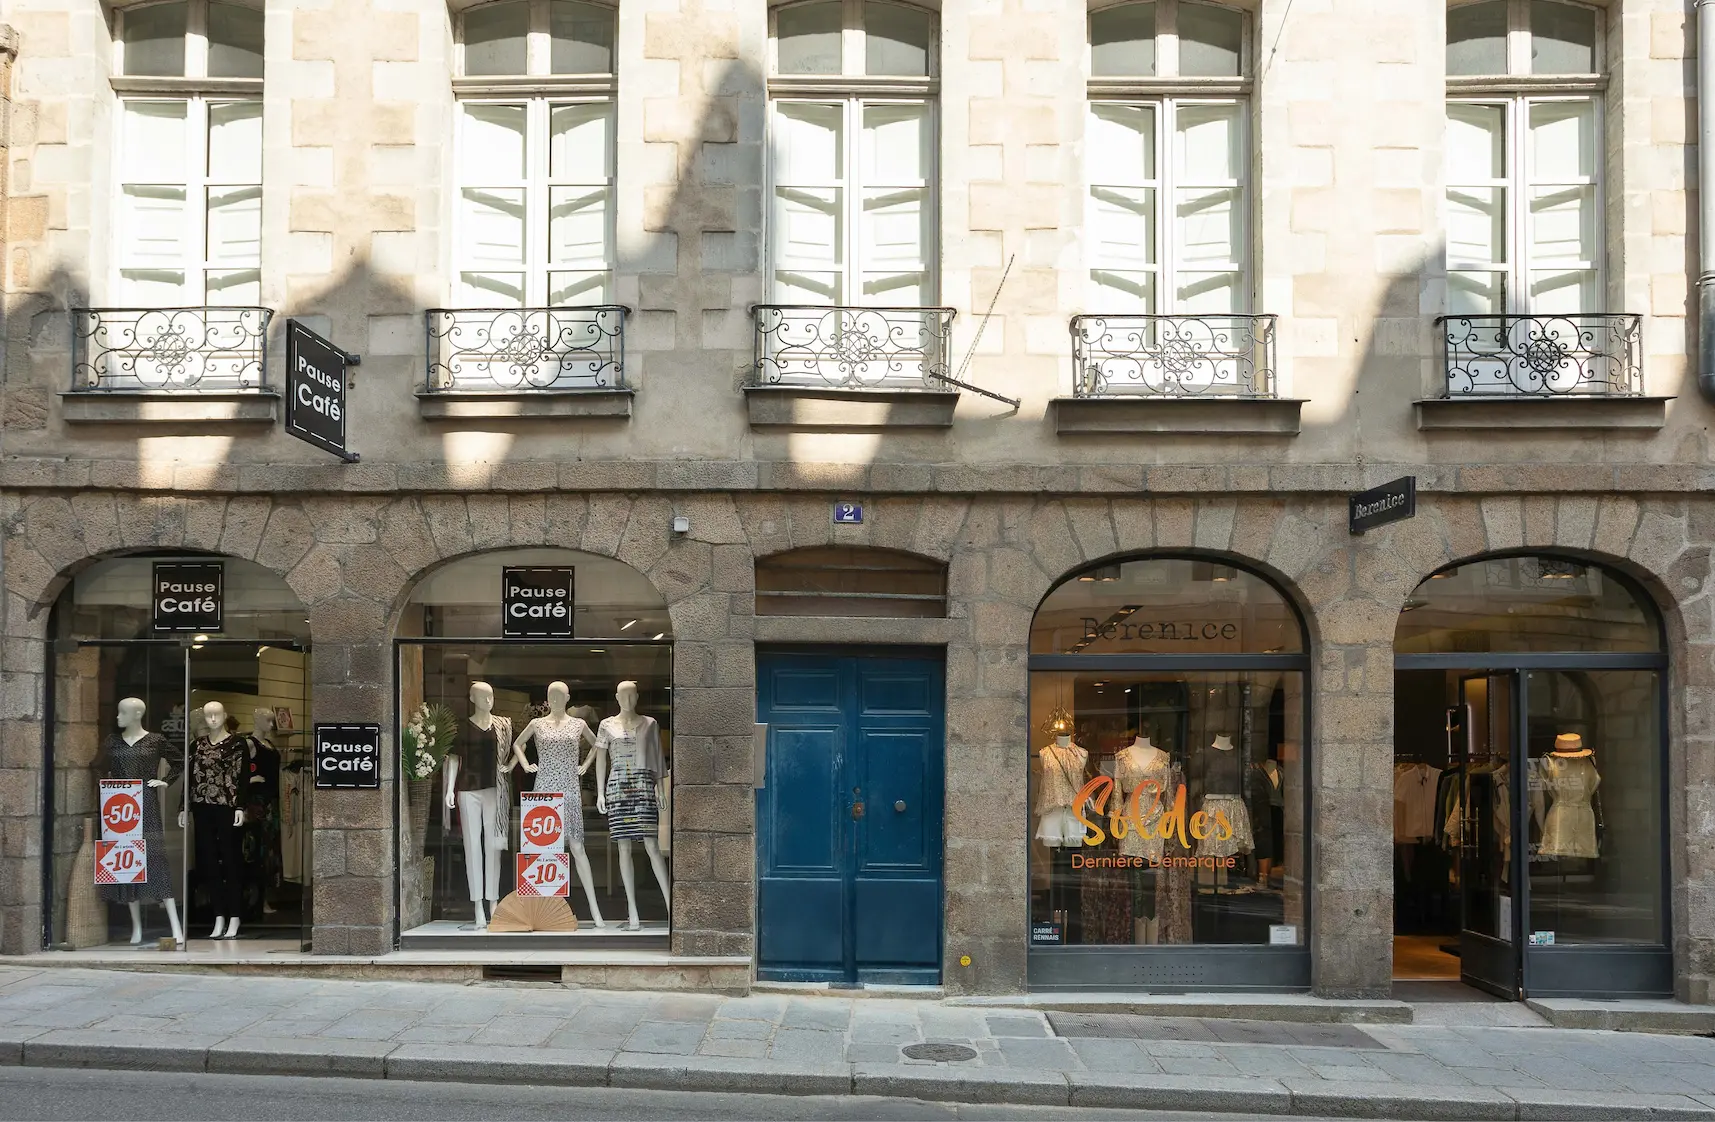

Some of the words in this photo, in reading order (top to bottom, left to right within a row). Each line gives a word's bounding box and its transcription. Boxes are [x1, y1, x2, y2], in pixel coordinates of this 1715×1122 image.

[298, 355, 341, 393] Pause
[298, 383, 341, 421] Café
[842, 503, 855, 520] 2
[1354, 493, 1405, 520] Berenice
[160, 581, 216, 593] Pause
[510, 586, 567, 598] Pause
[160, 596, 216, 613] Café
[510, 601, 567, 618] Café
[1080, 617, 1237, 640] Berenice
[321, 741, 374, 753] Pause
[321, 755, 374, 772] Café
[101, 781, 132, 789] SOLDES
[522, 791, 554, 802] SOLDES
[103, 803, 140, 825] -50%
[1072, 775, 1233, 849] Soldes
[523, 815, 562, 837] -50%
[1148, 852, 1236, 872] Démarque
[1033, 926, 1053, 934] CARRÉ
